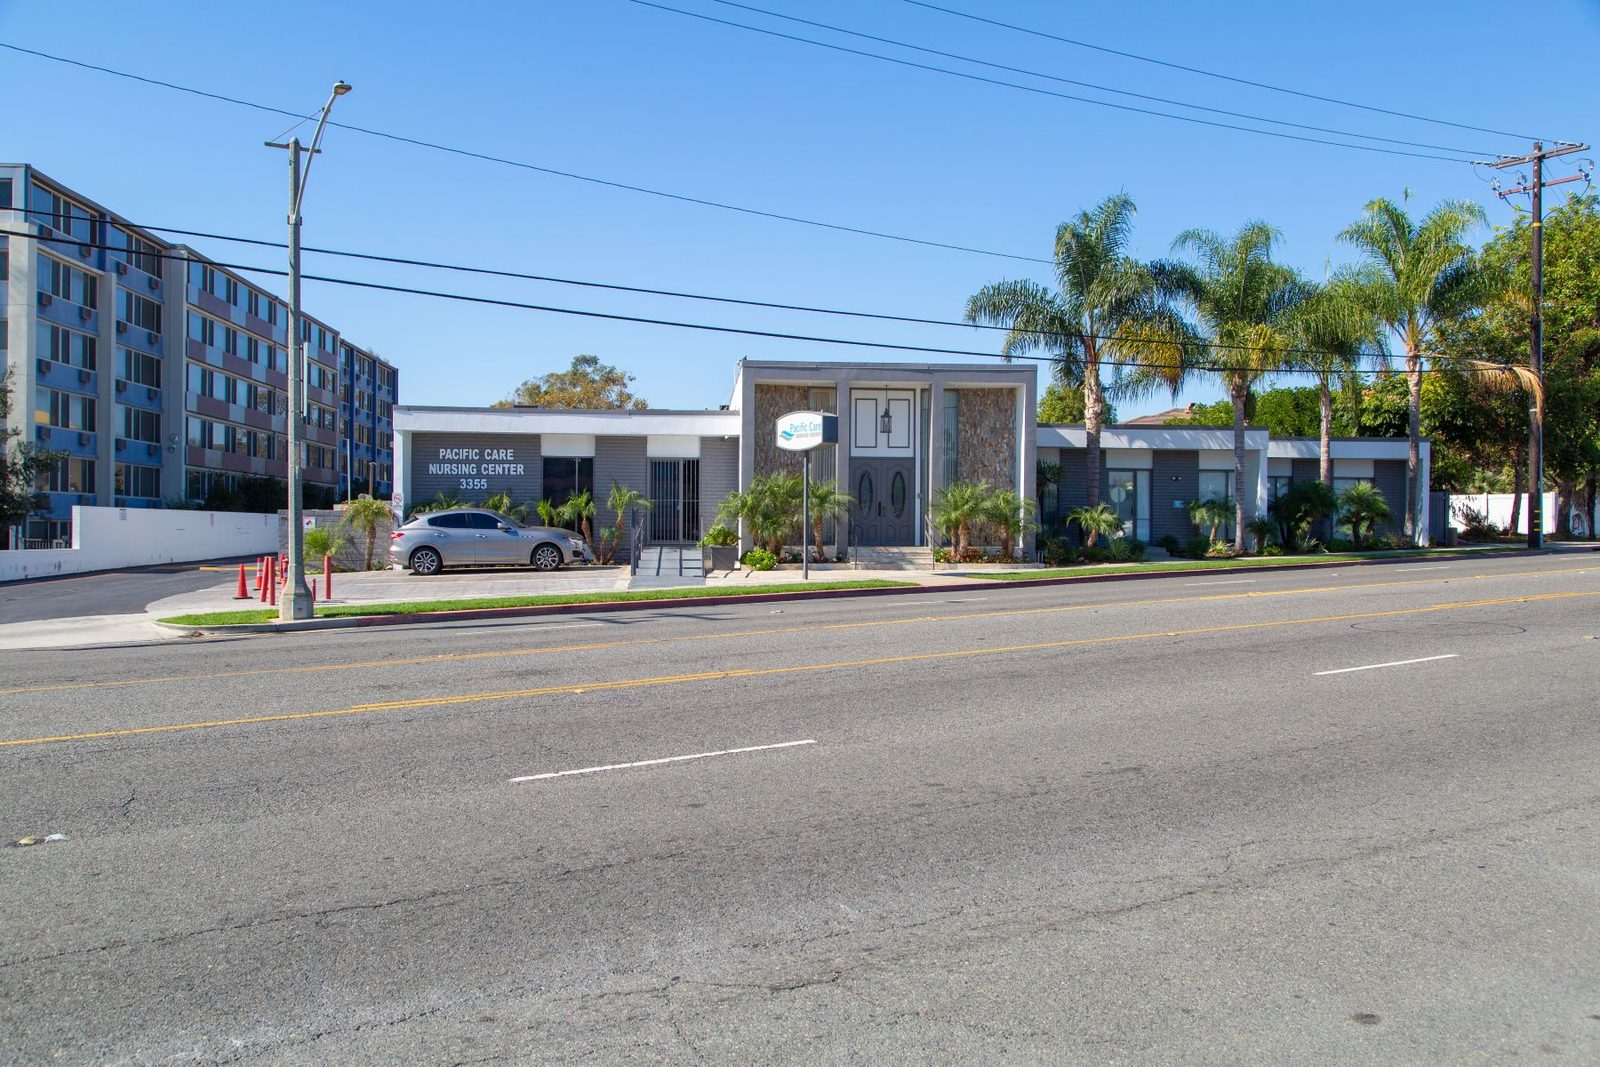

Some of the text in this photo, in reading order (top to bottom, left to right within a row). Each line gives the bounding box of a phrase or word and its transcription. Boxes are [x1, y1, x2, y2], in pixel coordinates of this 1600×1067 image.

[439, 448, 514, 460] PACIFIC CARE
[428, 463, 525, 475] NURSING CENTER
[459, 478, 488, 490] 3355
